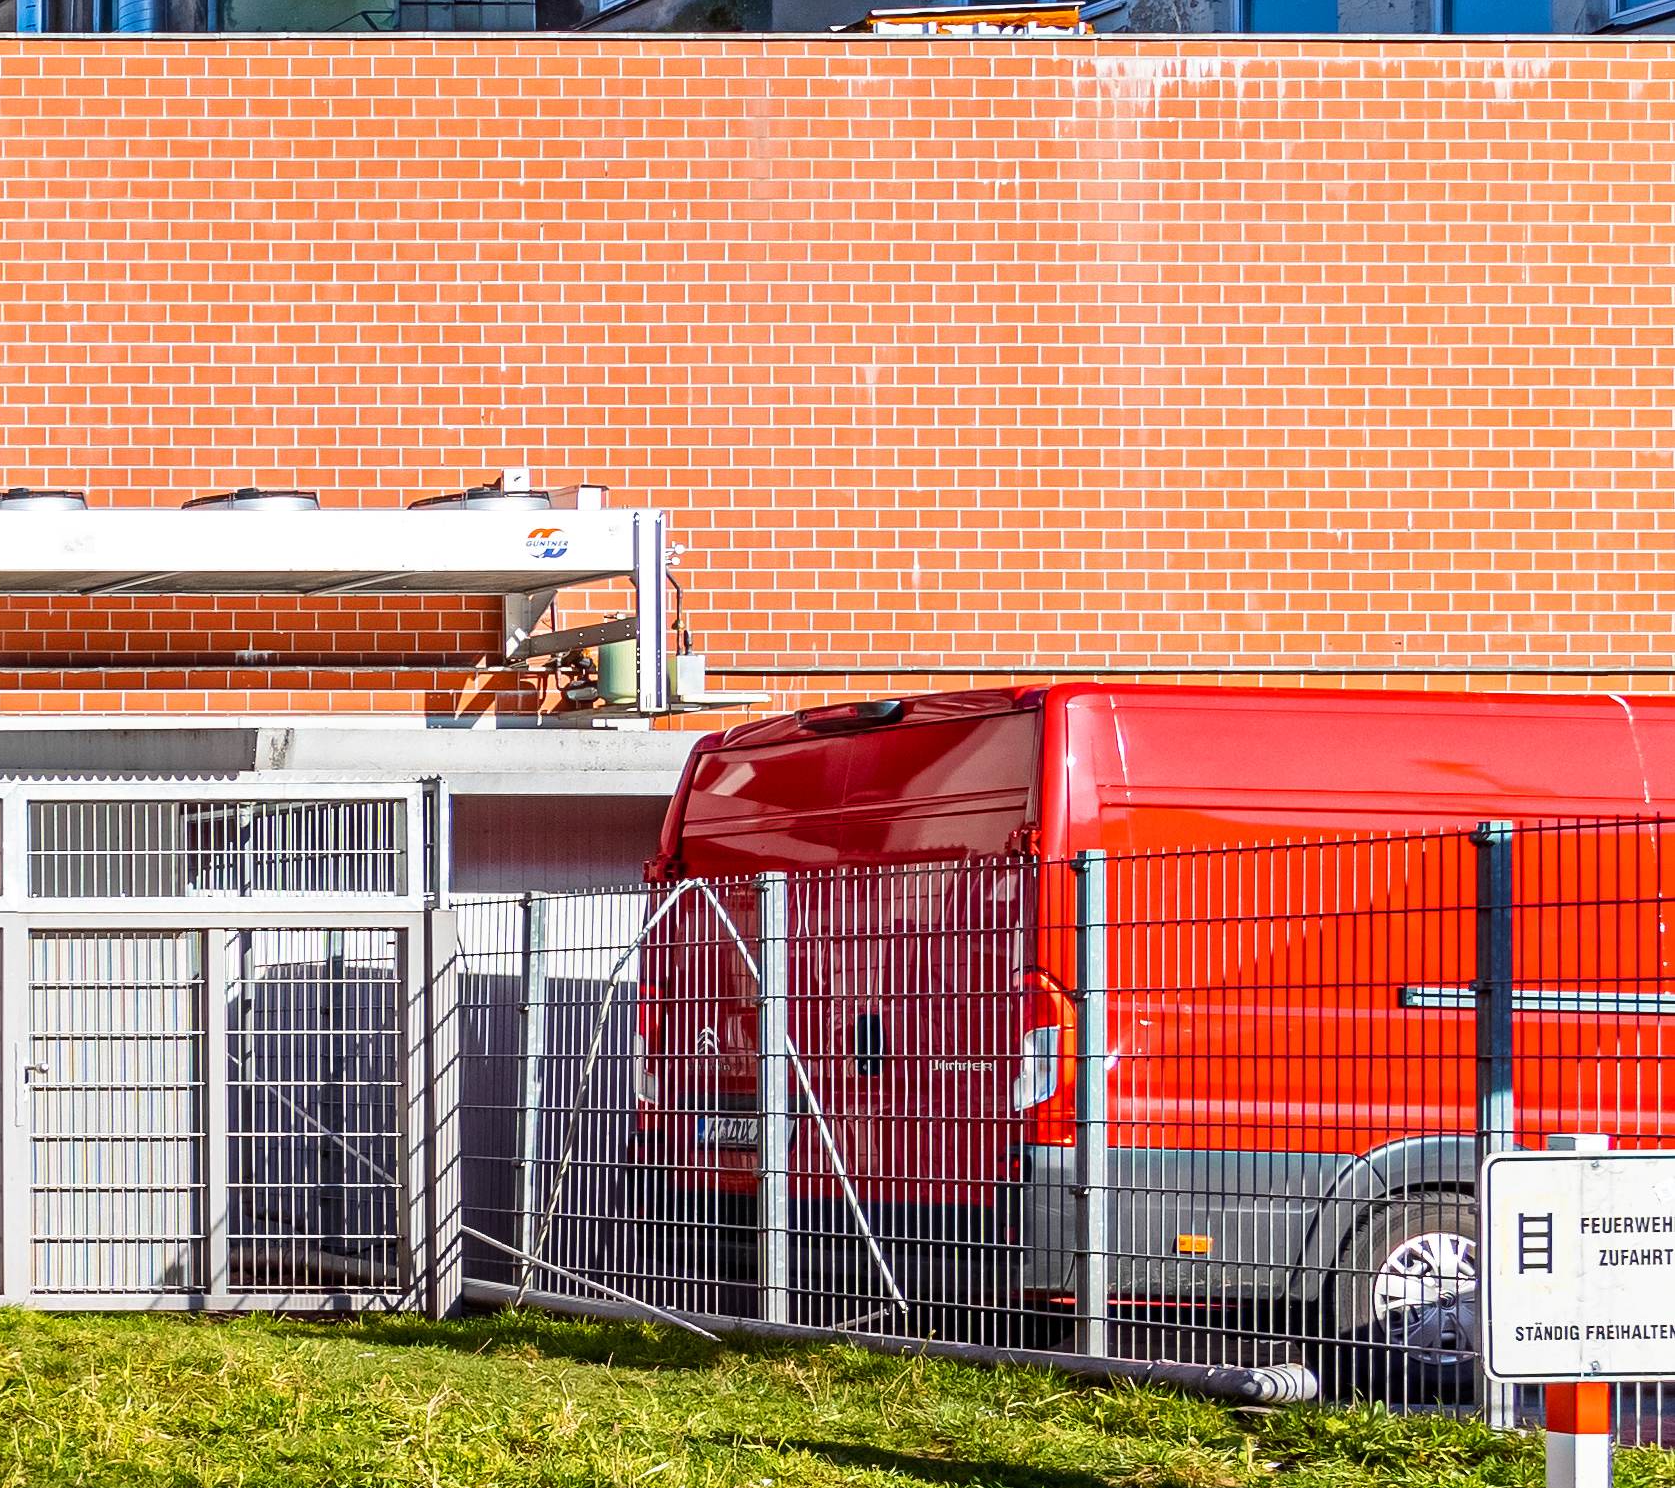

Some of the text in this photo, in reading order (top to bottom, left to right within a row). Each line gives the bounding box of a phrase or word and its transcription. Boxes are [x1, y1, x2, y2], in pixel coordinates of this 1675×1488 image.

[1580, 1216, 1675, 1234] FEUERWEH
[1599, 1249, 1674, 1266] ZUFAHRT
[1515, 1322, 1580, 1342] STÄNDIG
